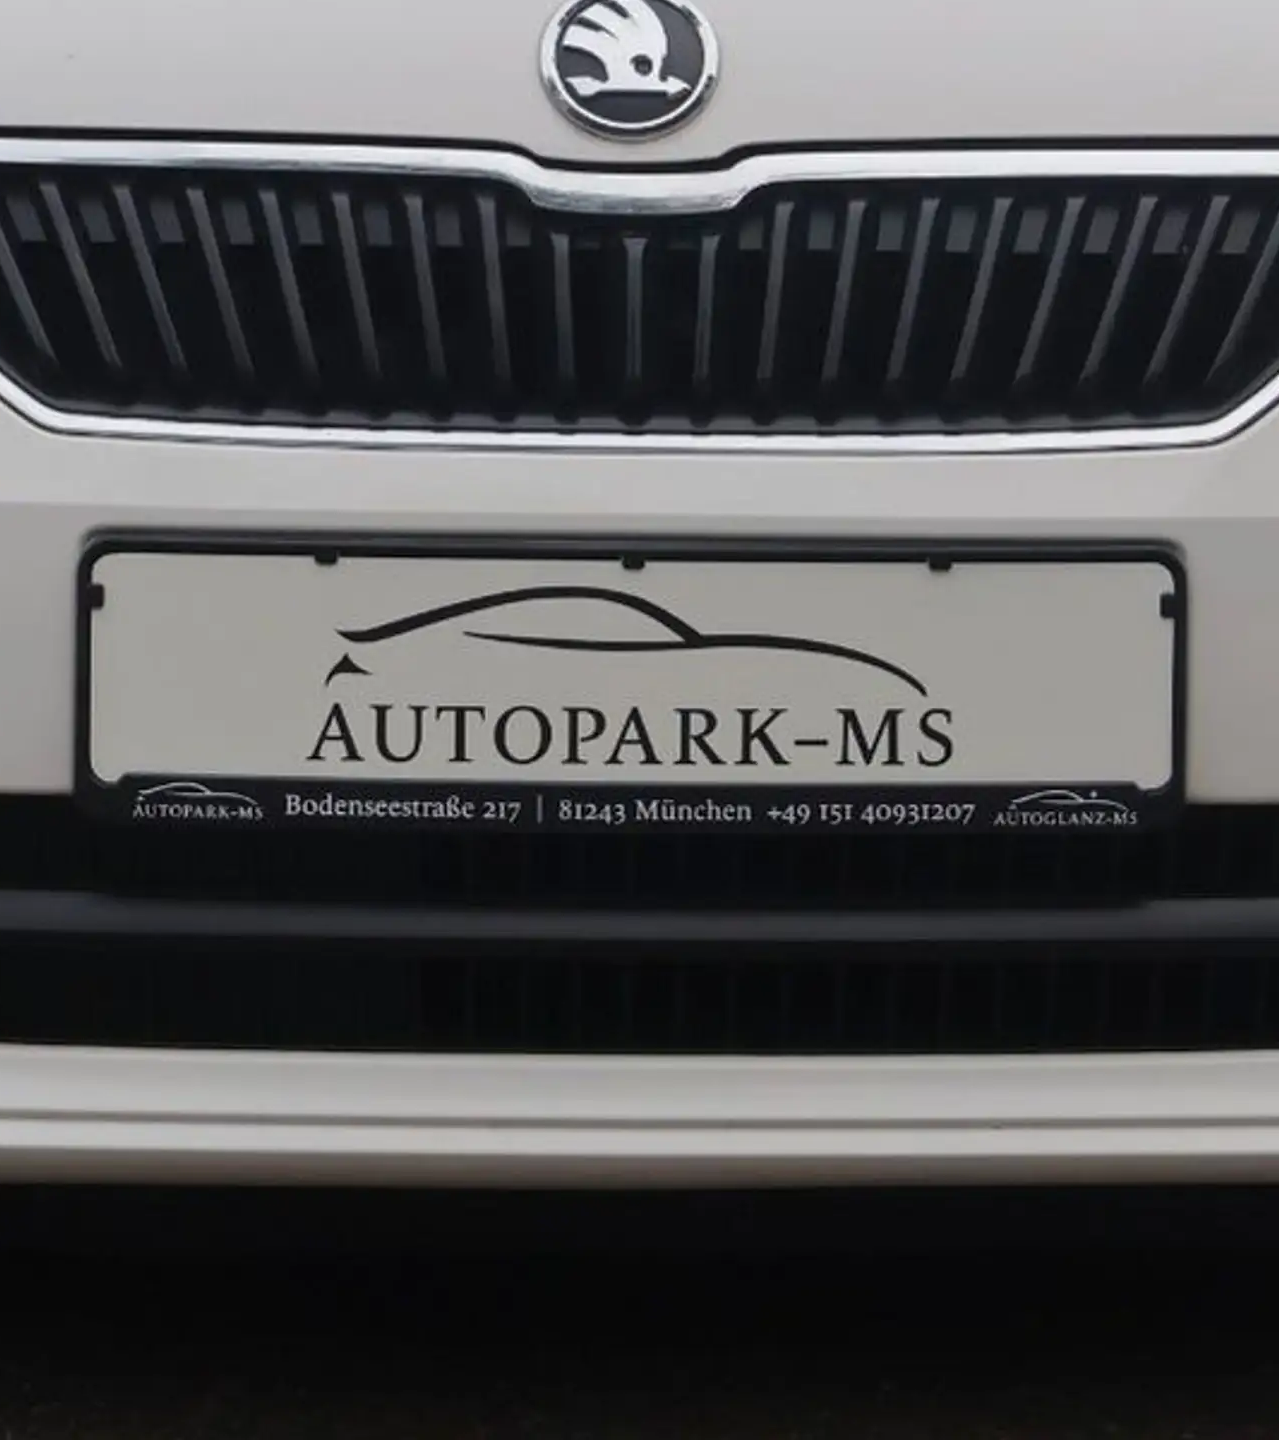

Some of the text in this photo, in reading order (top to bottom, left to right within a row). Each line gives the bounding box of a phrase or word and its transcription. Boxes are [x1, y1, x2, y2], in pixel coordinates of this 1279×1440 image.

[306, 702, 953, 768] AUTOPARK-MS
[132, 802, 263, 820] AUTOPARK-MS
[285, 792, 977, 825] Bodenseestraße 217 81243 München +49 151 40931207
[993, 810, 1138, 826] AUTOGLANZ-MS
